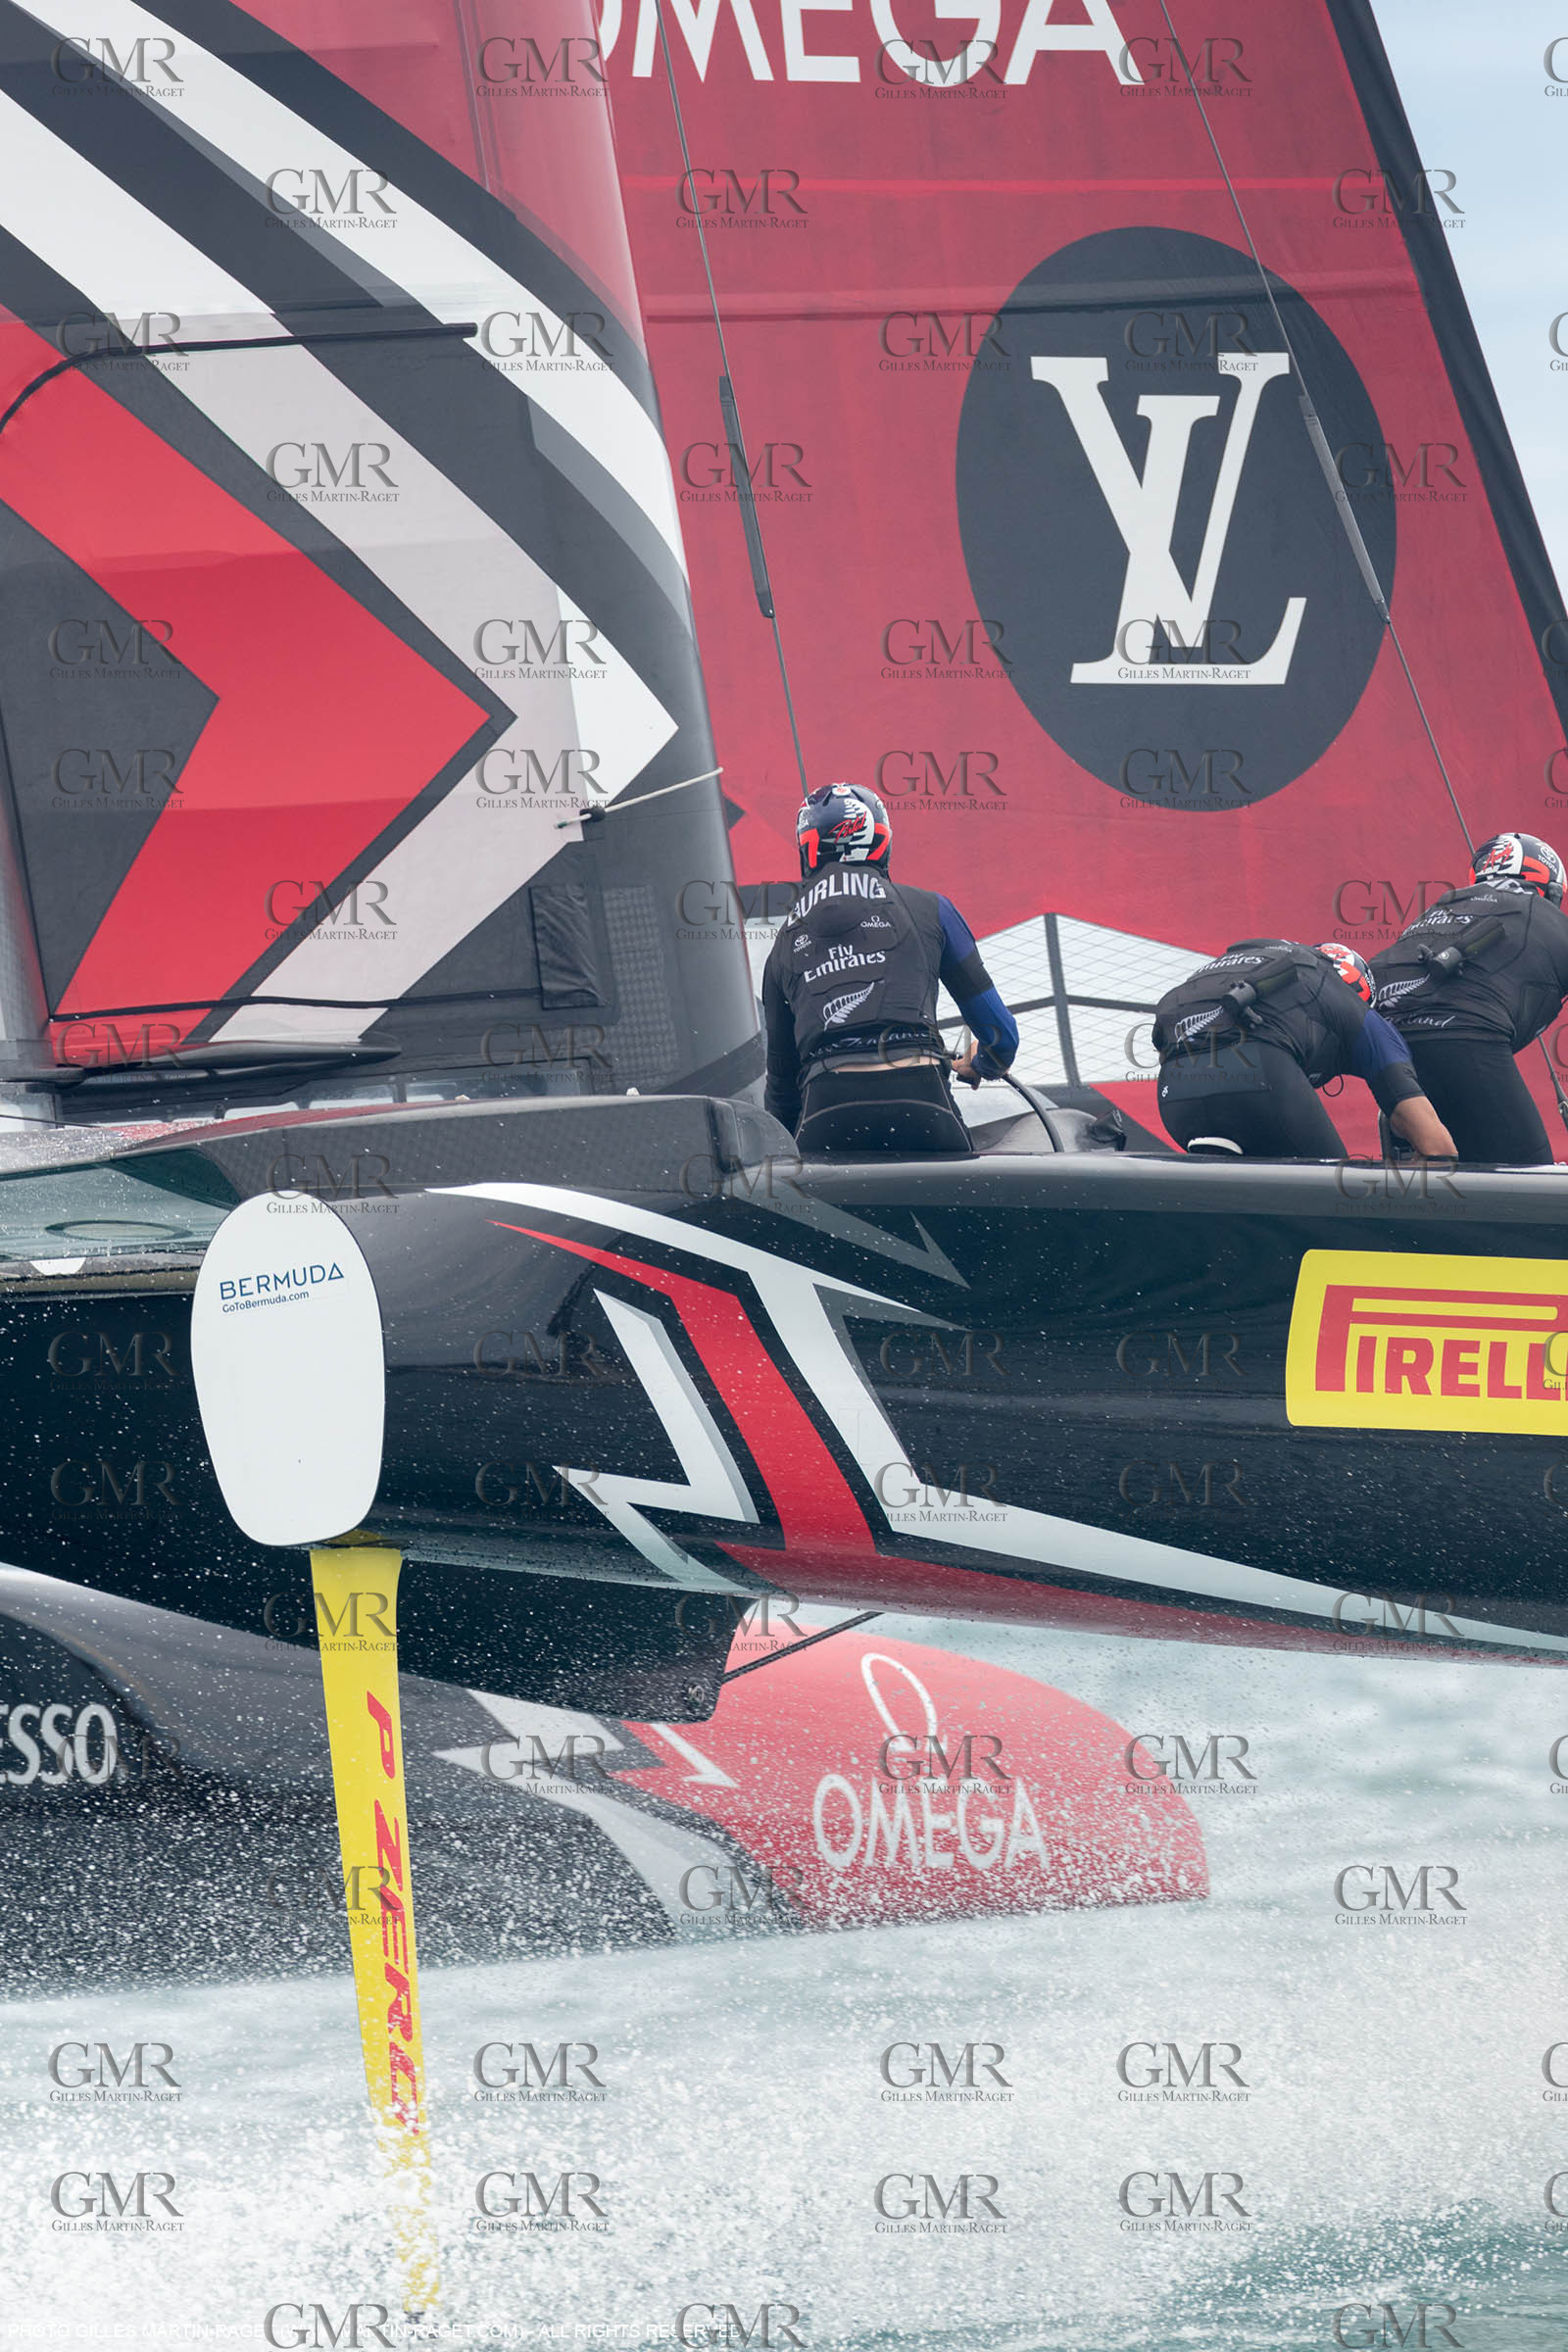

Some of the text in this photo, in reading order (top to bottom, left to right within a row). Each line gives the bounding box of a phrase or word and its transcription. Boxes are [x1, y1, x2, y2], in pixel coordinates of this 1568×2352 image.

[1538, 855, 1558, 875] TOYOTA
[787, 871, 886, 927] BURLING
[793, 939, 812, 954] TOYOTA
[828, 944, 854, 960] Fly
[804, 950, 886, 983] Emirates
[220, 1262, 345, 1300] BERMUDA
[221, 1291, 310, 1313] GoToBermuda.com
[1315, 1284, 1568, 1401] PIRELL
[0, 1703, 118, 1785] SSO
[812, 1773, 1051, 1869] OMEGA
